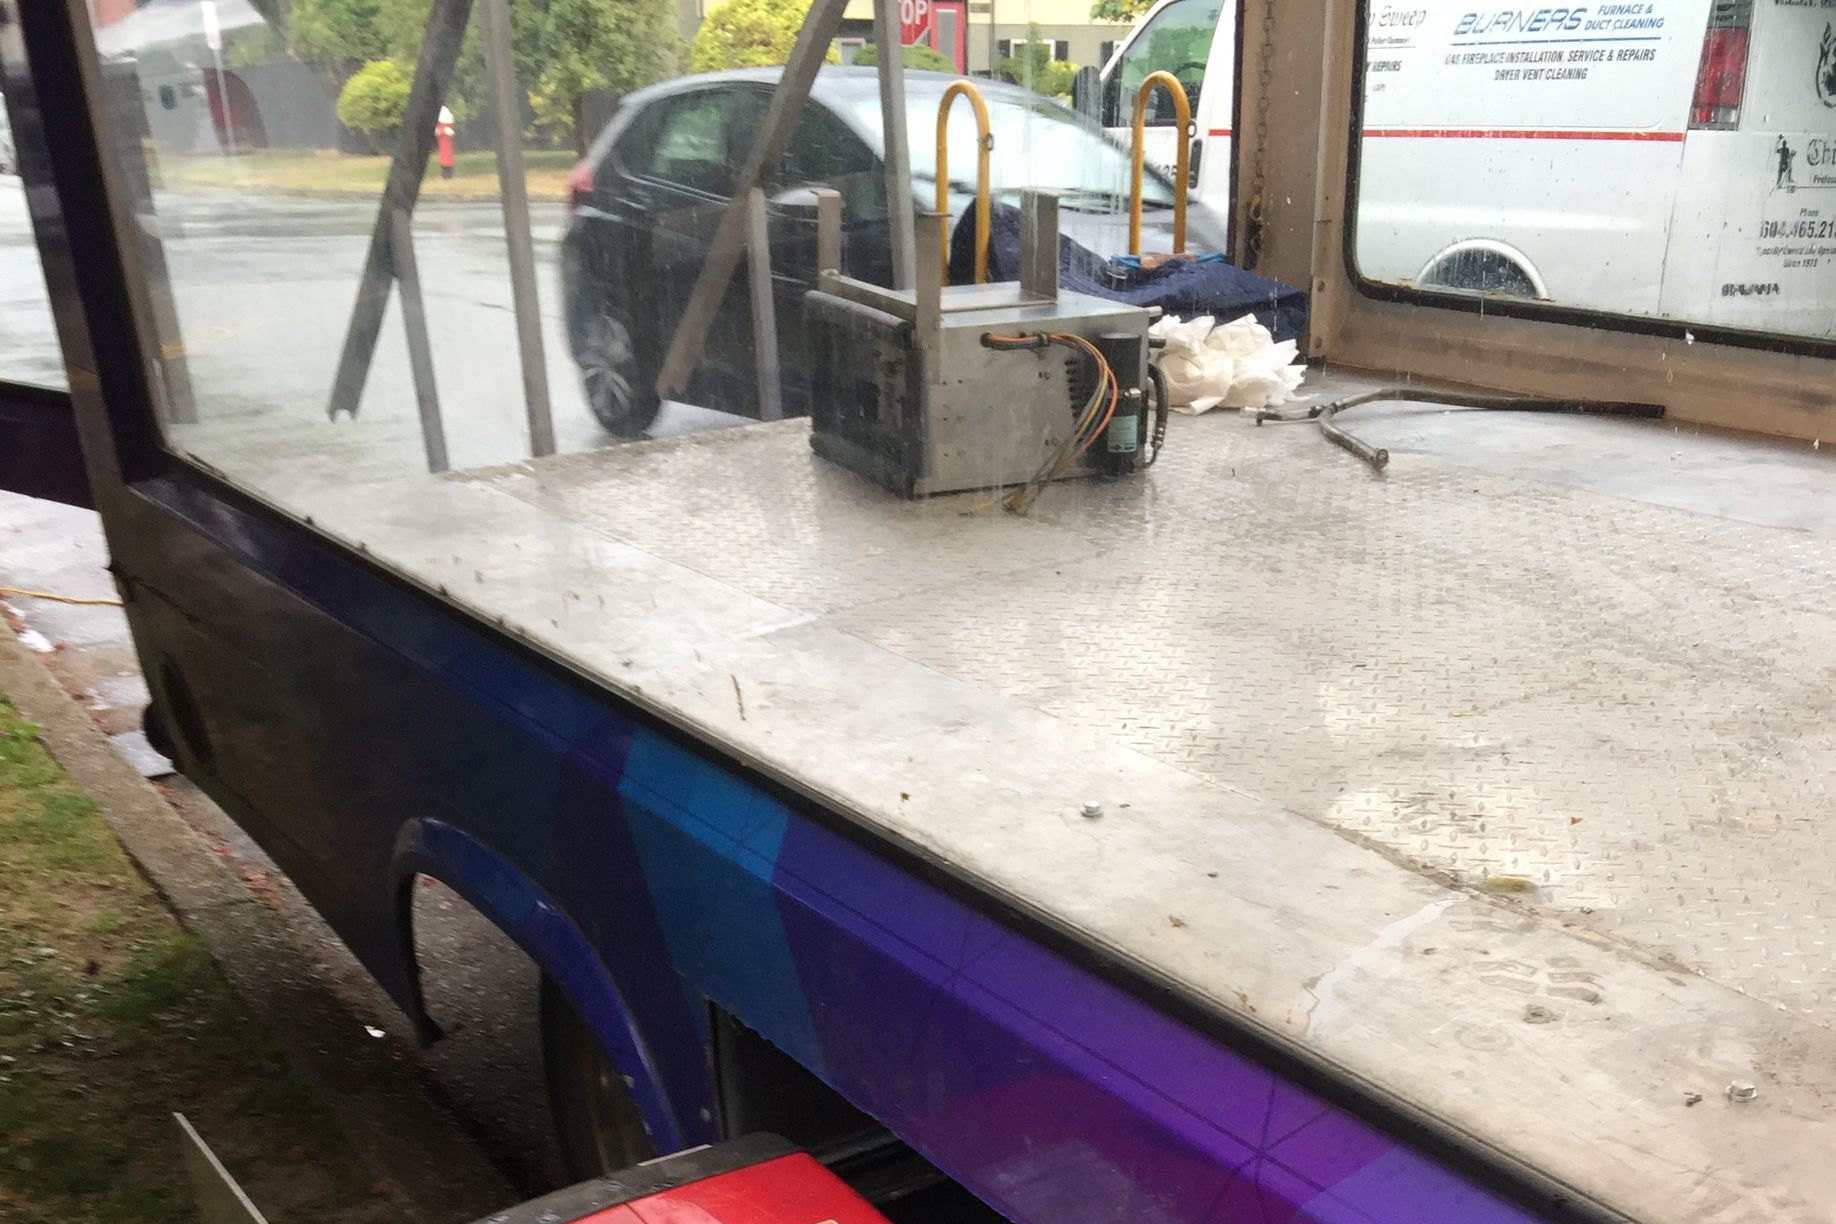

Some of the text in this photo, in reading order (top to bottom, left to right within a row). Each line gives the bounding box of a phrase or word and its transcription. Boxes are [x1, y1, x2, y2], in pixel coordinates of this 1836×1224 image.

[1597, 4, 1653, 15] FURNACE &
[1453, 8, 1587, 35] BURNERS
[1584, 18, 1664, 31] DUCT CLEANING
[1462, 52, 1505, 64] FIREPLACE
[1567, 50, 1605, 62] SERVICE
[1606, 50, 1614, 61] &
[1616, 49, 1656, 61] REPAIRS
[1494, 68, 1588, 81] DRYER VENT CLEANING
